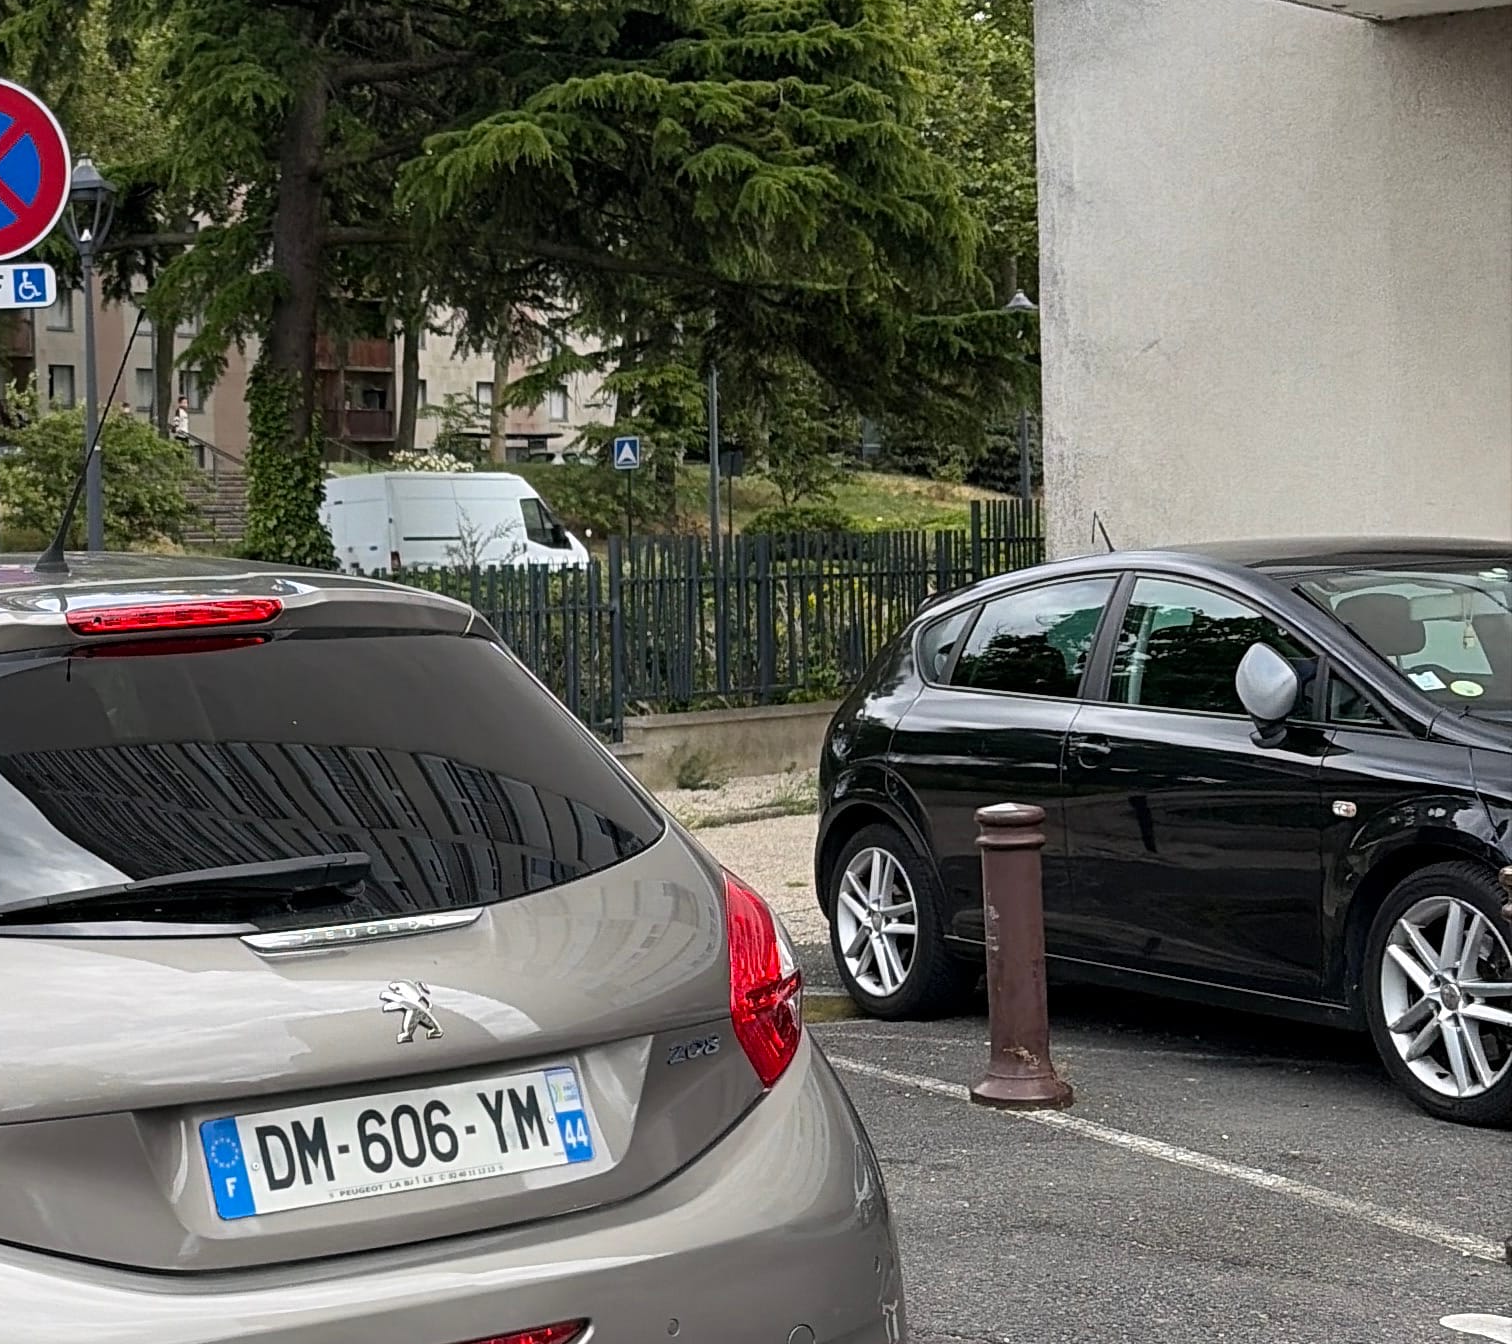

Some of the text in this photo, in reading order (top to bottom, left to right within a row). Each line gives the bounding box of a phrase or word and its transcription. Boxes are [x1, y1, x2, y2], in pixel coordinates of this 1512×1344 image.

[304, 917, 439, 944] PEUGEOT
[255, 1084, 550, 1192] DM-606-YM
[565, 1117, 589, 1148] 44
[225, 1176, 238, 1198] F
[339, 1184, 383, 1197] PEUGEOT
